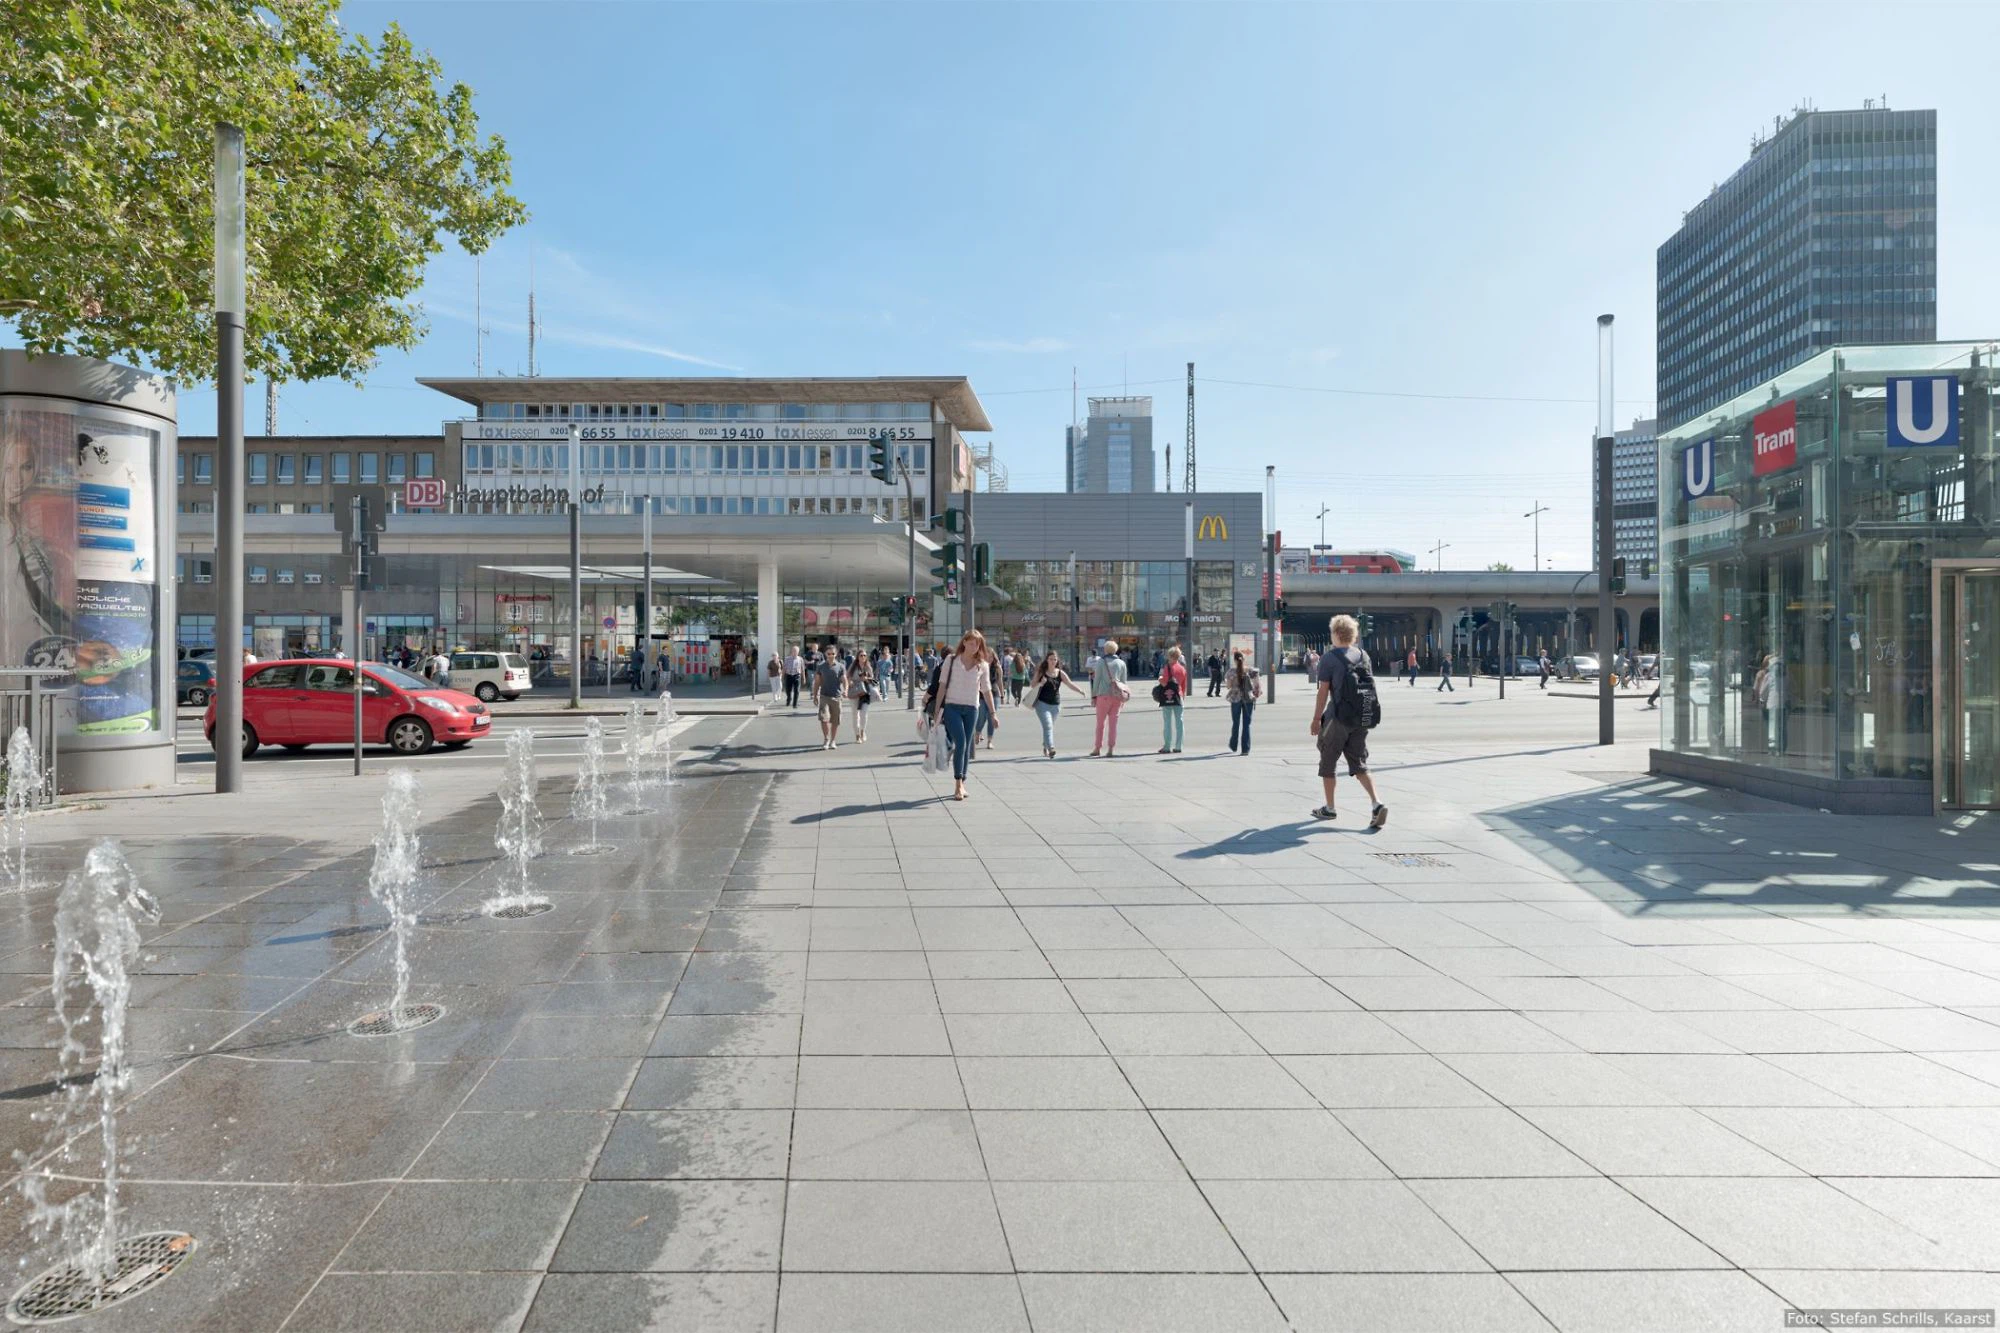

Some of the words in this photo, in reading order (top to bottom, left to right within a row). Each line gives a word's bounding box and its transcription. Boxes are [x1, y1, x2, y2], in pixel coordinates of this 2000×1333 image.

[1896, 379, 1949, 444] U
[581, 427, 597, 439] 66
[600, 427, 616, 439] 55
[698, 427, 717, 436] 0201
[721, 428, 737, 439] 19
[740, 428, 764, 439] 410
[847, 427, 866, 435] 0201
[868, 427, 877, 439] 8
[900, 427, 915, 439] 55
[1755, 427, 1795, 455] Tram
[1686, 440, 1711, 496] U
[409, 483, 439, 503] DB
[454, 484, 606, 507] Hauptbahnof
[1164, 614, 1221, 623] Mcnald's
[33, 648, 77, 668] 24
